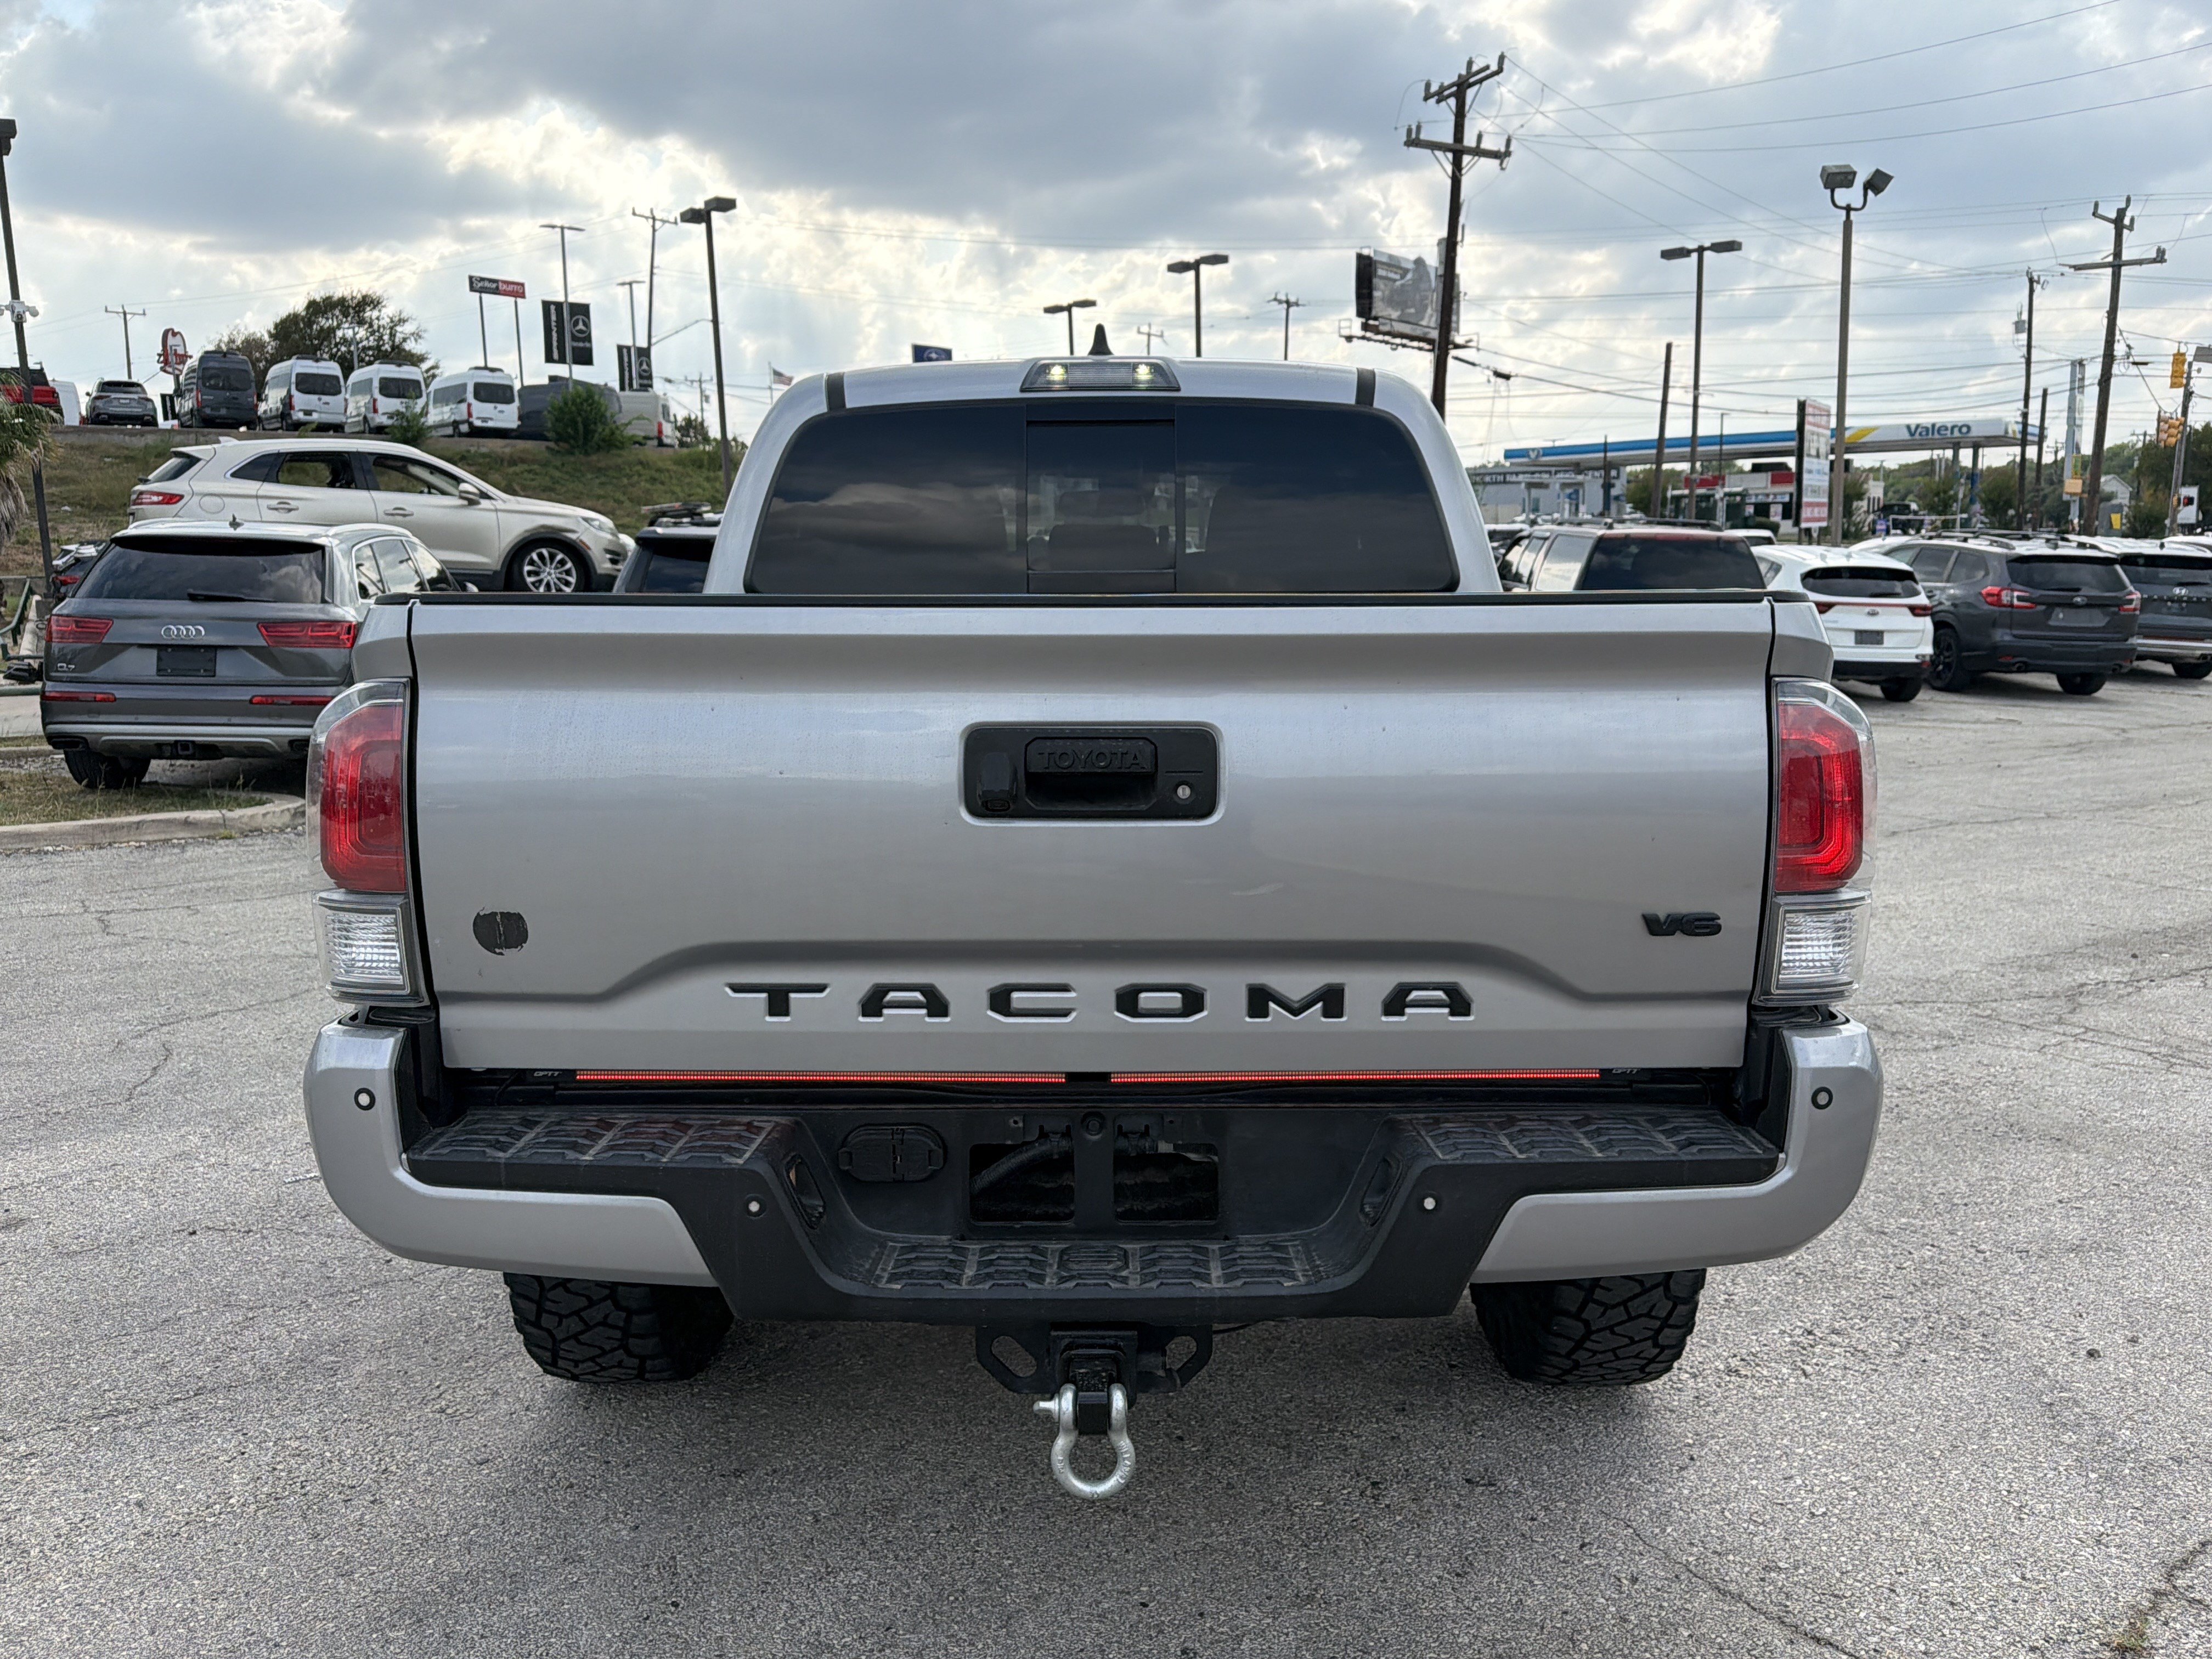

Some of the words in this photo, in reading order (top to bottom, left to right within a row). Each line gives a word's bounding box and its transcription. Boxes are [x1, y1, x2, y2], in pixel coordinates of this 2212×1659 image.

[1906, 422, 1972, 438] Valero
[57, 663, 75, 671] Q7
[1038, 749, 1148, 769] TOYOTA
[1641, 912, 1722, 936] V6
[725, 983, 1475, 1022] TACOMA
